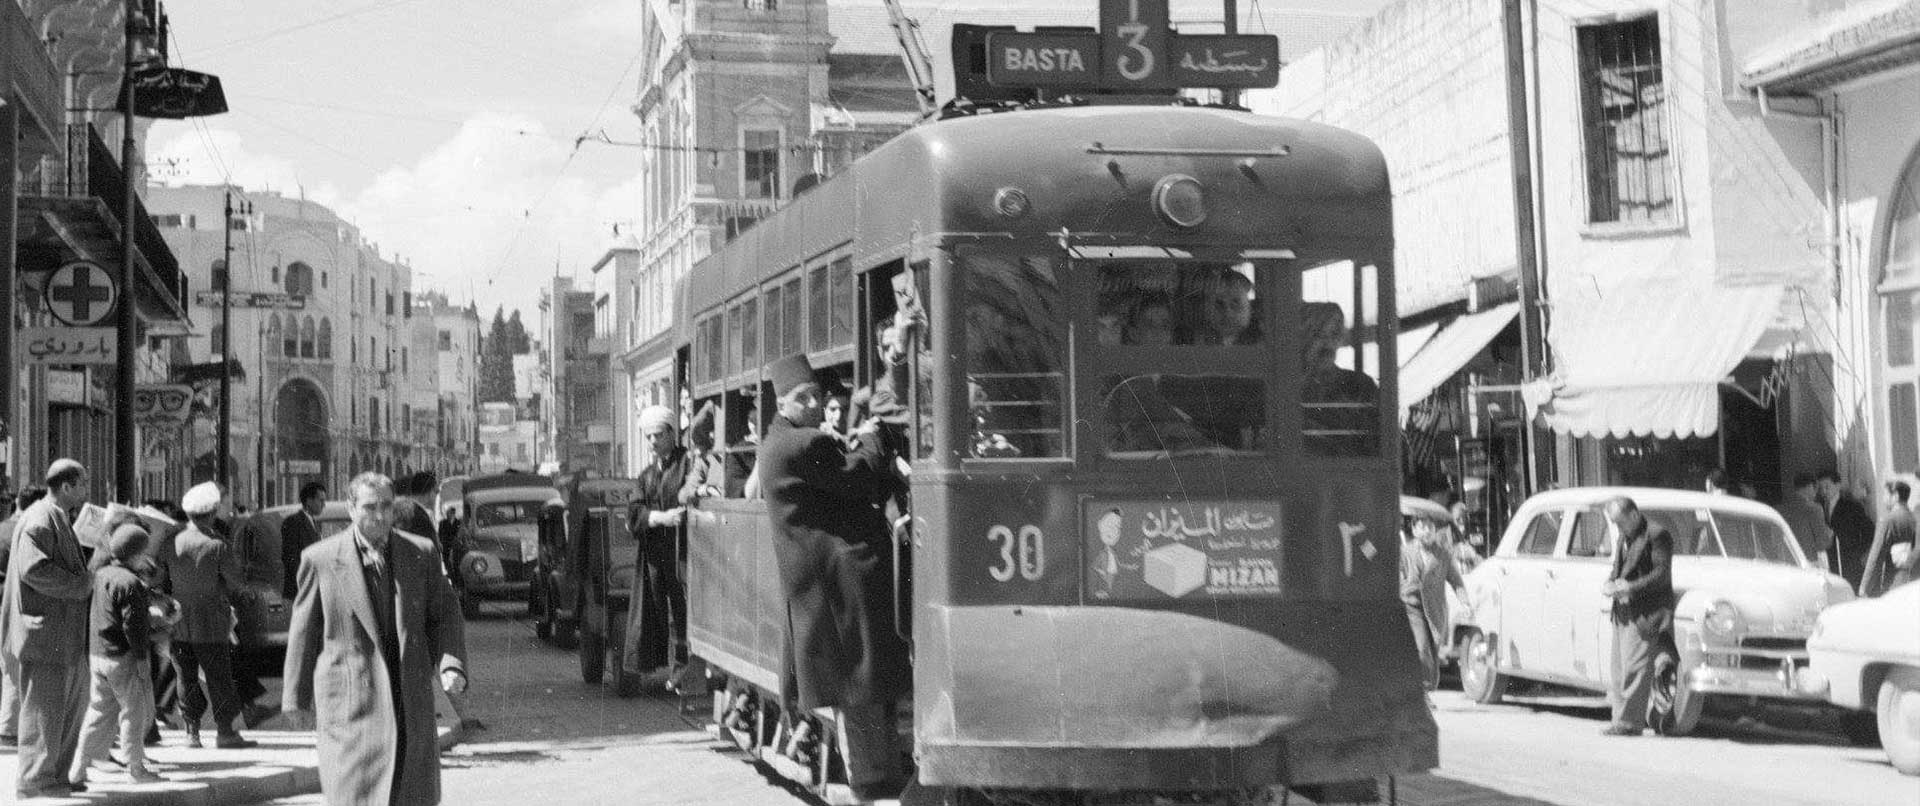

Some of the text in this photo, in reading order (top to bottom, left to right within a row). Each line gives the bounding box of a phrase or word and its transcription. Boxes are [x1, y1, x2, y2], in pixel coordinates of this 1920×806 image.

[1004, 48, 1085, 72] BASTA
[1117, 23, 1155, 80] 3
[987, 524, 1044, 582] 30
[1209, 567, 1280, 586] MIZAN
